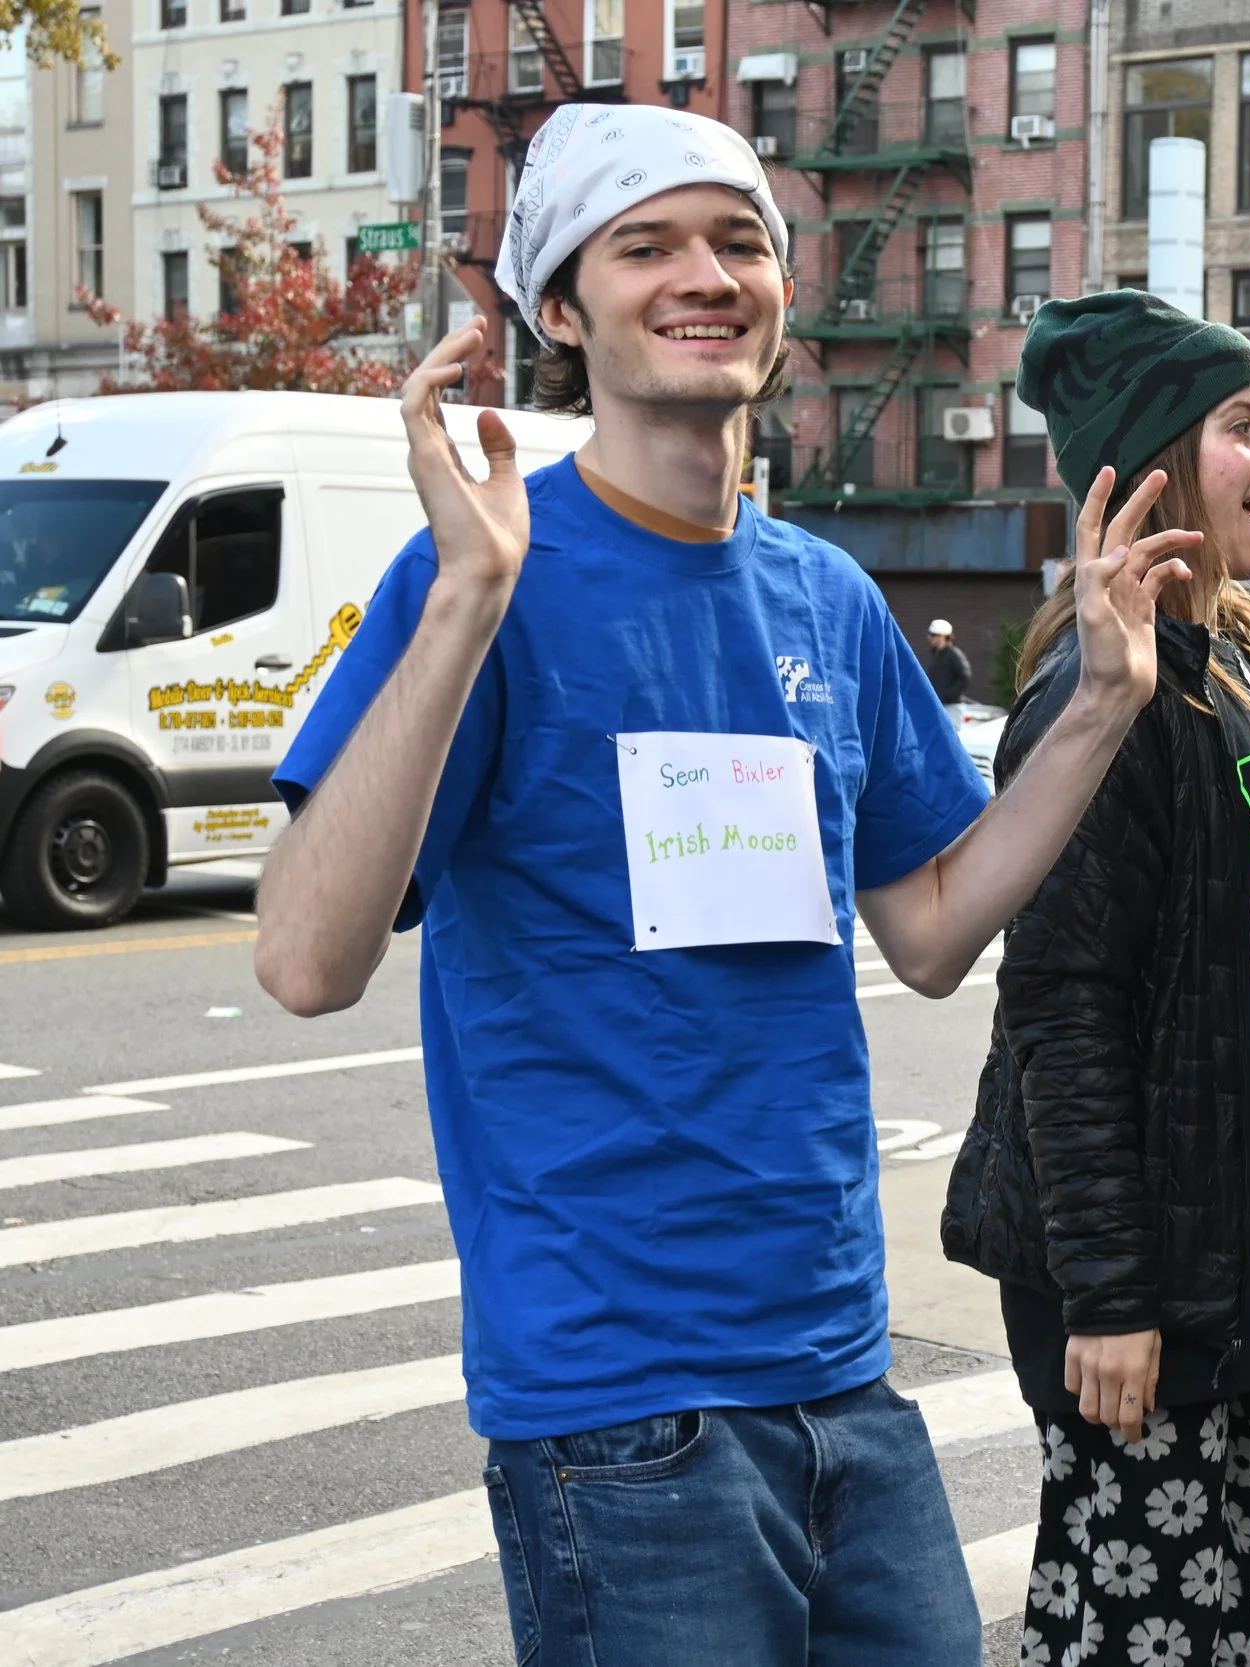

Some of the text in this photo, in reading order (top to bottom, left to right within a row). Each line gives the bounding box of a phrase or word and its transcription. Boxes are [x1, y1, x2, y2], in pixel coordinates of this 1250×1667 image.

[359, 227, 404, 251] Straus
[660, 759, 785, 789] Sean Bixler
[645, 821, 798, 864] Irish Moose
